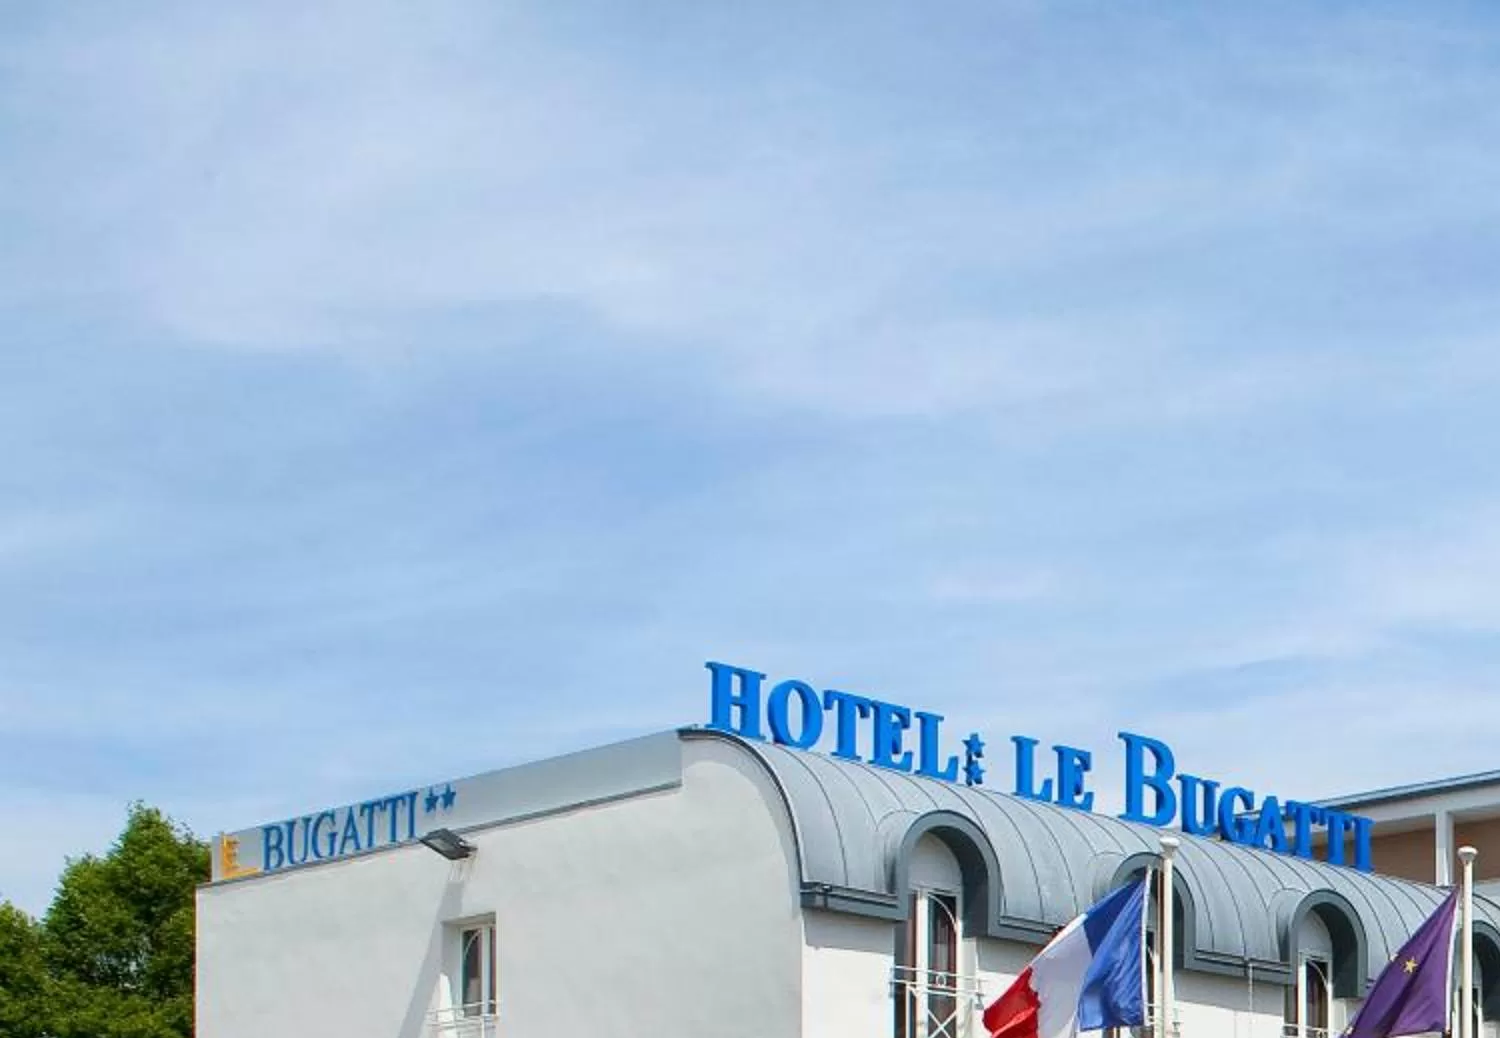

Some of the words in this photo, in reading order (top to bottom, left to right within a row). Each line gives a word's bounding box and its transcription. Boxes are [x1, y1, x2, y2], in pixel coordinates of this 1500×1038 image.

[261, 791, 418, 871] BUGATTI
[704, 661, 960, 784] HOTEL
[1010, 734, 1095, 812] LE
[1116, 731, 1375, 873] BUGATTI
